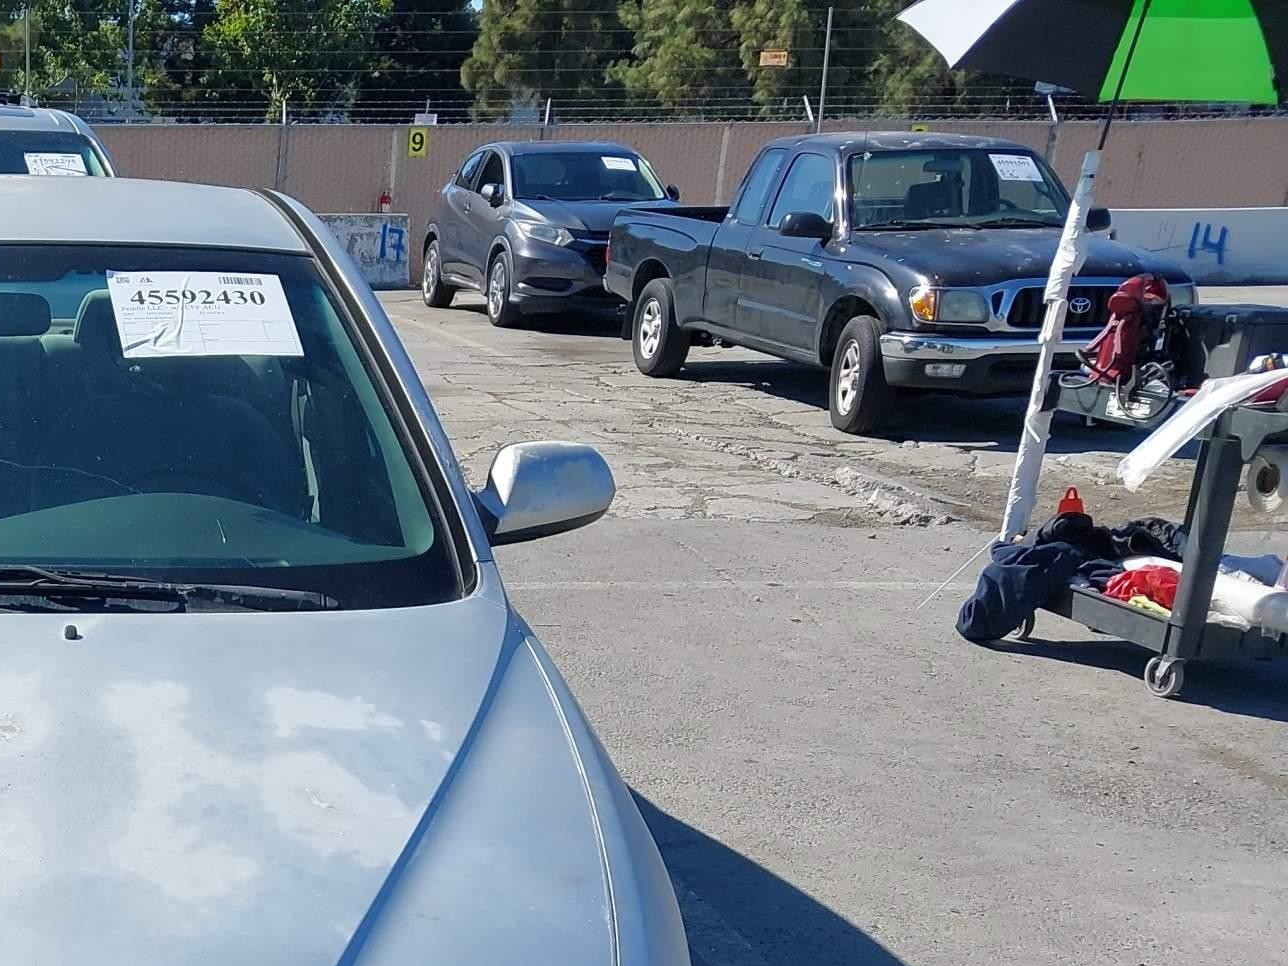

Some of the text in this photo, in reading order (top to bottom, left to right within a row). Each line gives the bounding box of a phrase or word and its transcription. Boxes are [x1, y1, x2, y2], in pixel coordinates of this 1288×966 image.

[412, 132, 424, 152] 9
[379, 224, 404, 262] 17
[1188, 222, 1228, 265] 14
[130, 289, 266, 306] 45592430
